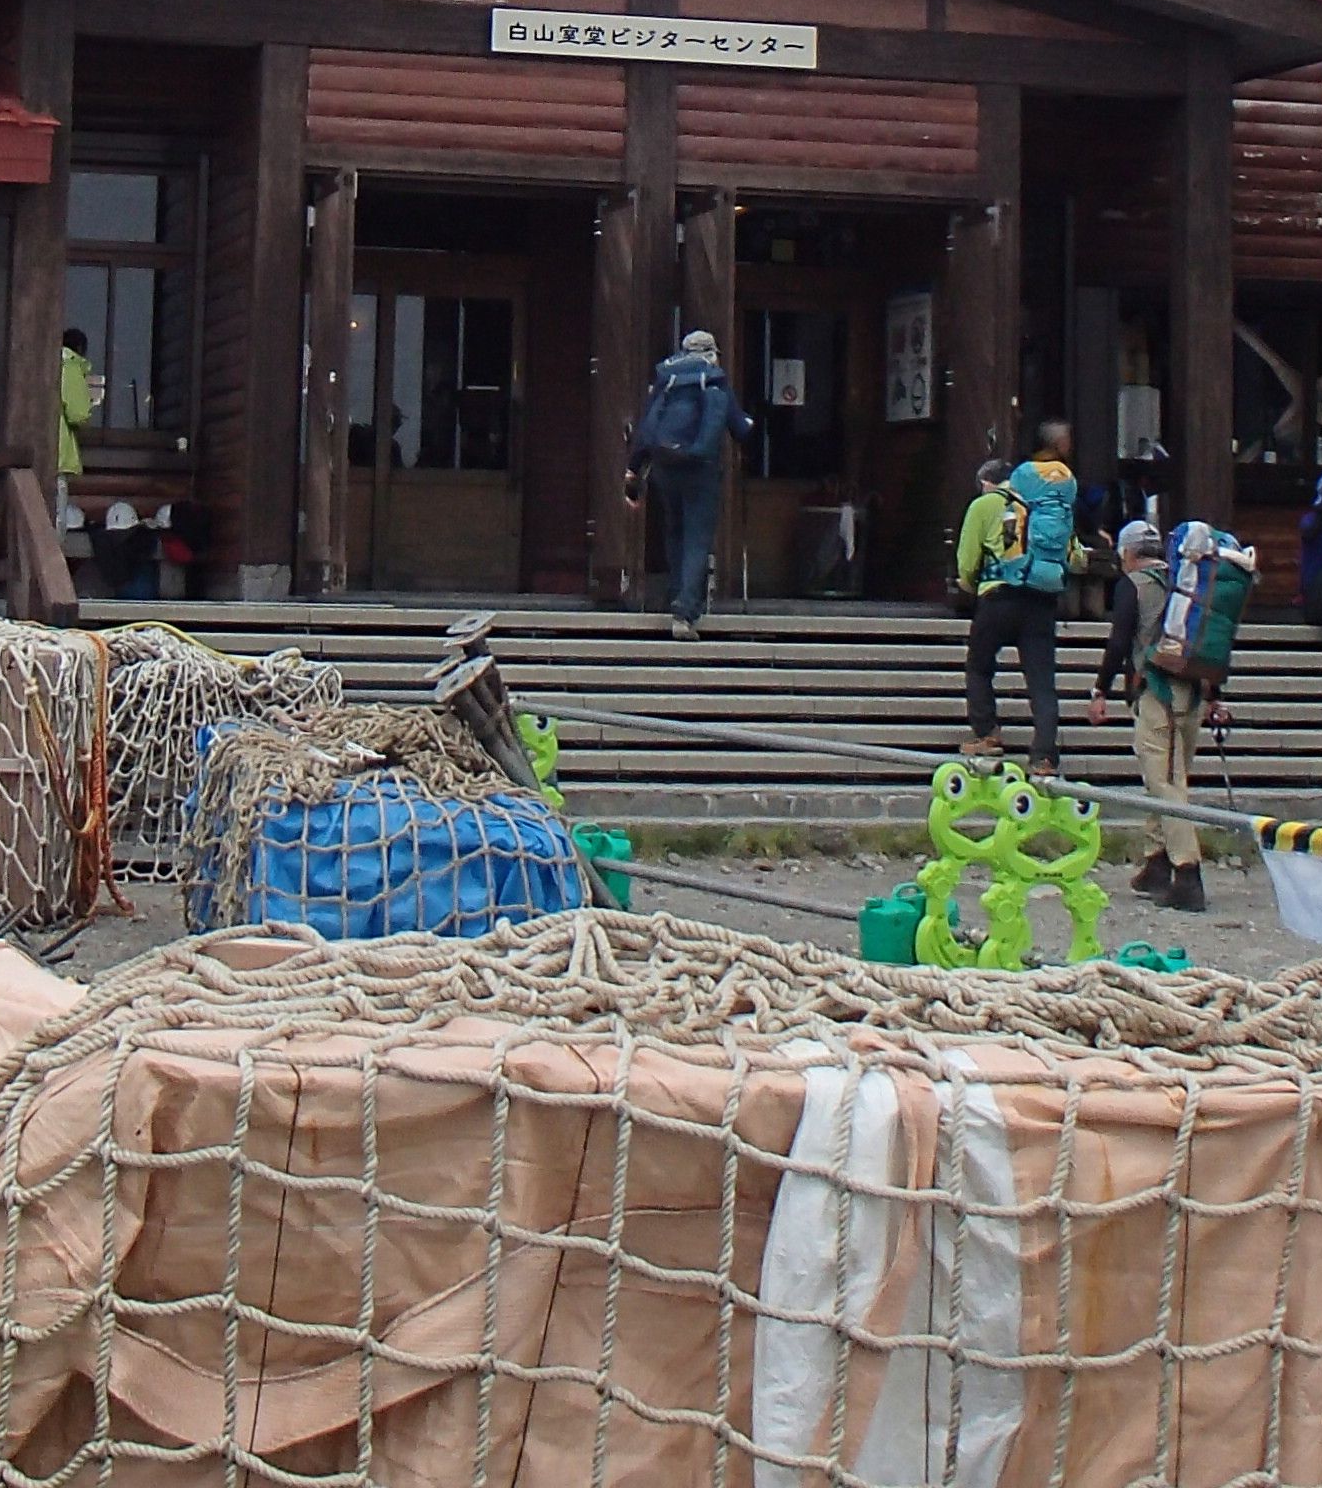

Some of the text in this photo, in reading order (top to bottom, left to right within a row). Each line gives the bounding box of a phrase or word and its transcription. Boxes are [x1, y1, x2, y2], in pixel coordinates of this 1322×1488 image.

[508, 21, 805, 54] 白山室堂ビジターセンター
